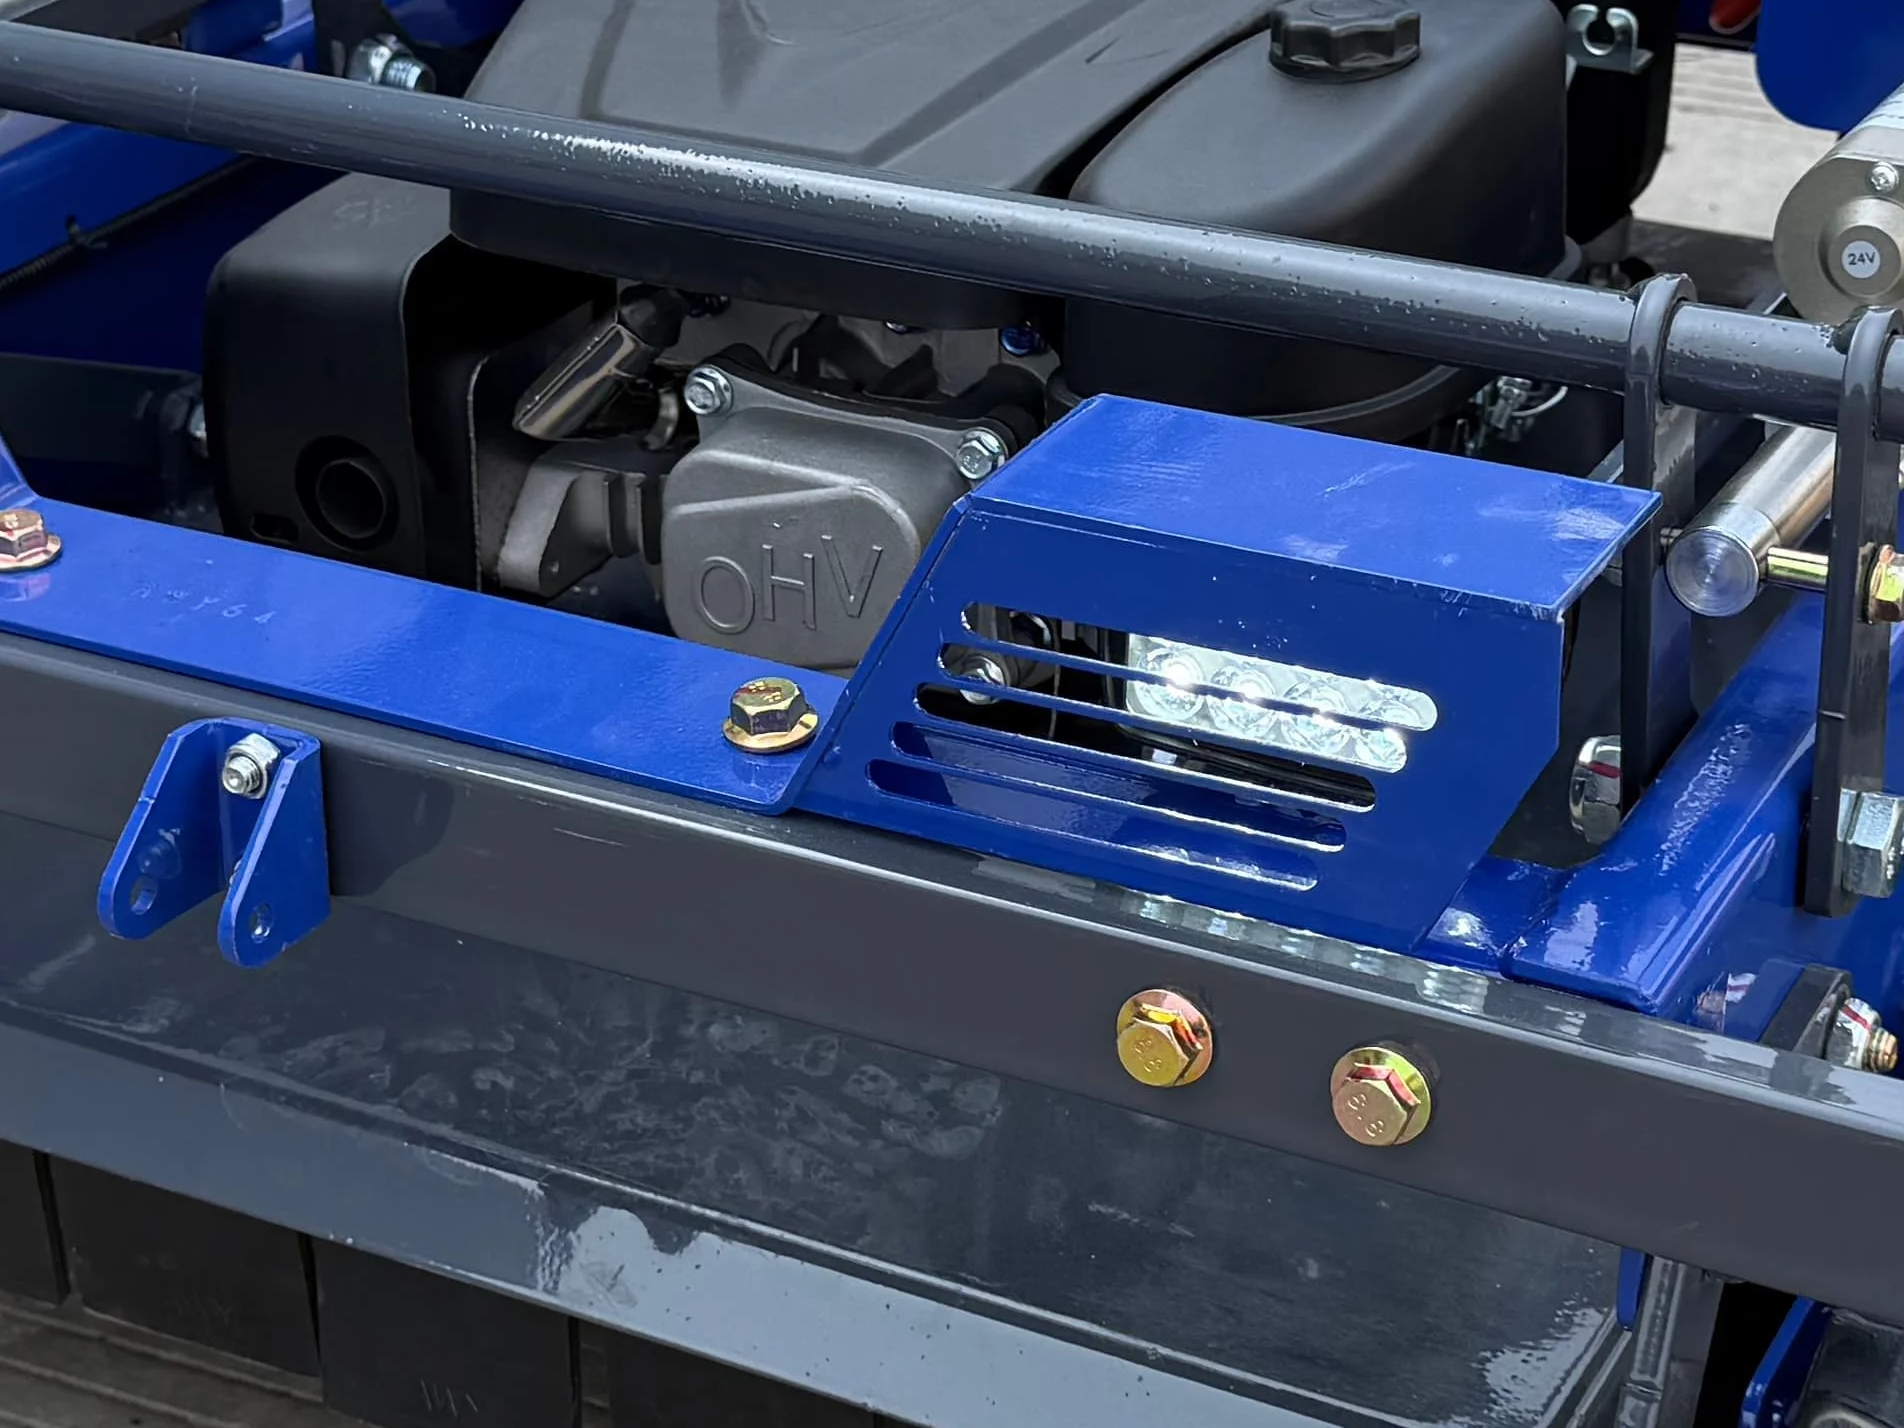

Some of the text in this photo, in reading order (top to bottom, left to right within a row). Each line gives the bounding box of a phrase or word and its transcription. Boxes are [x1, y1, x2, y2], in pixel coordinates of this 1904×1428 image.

[1847, 251, 1876, 266] 24V
[694, 533, 884, 636] OHV
[1346, 1092, 1386, 1139] 8.8
